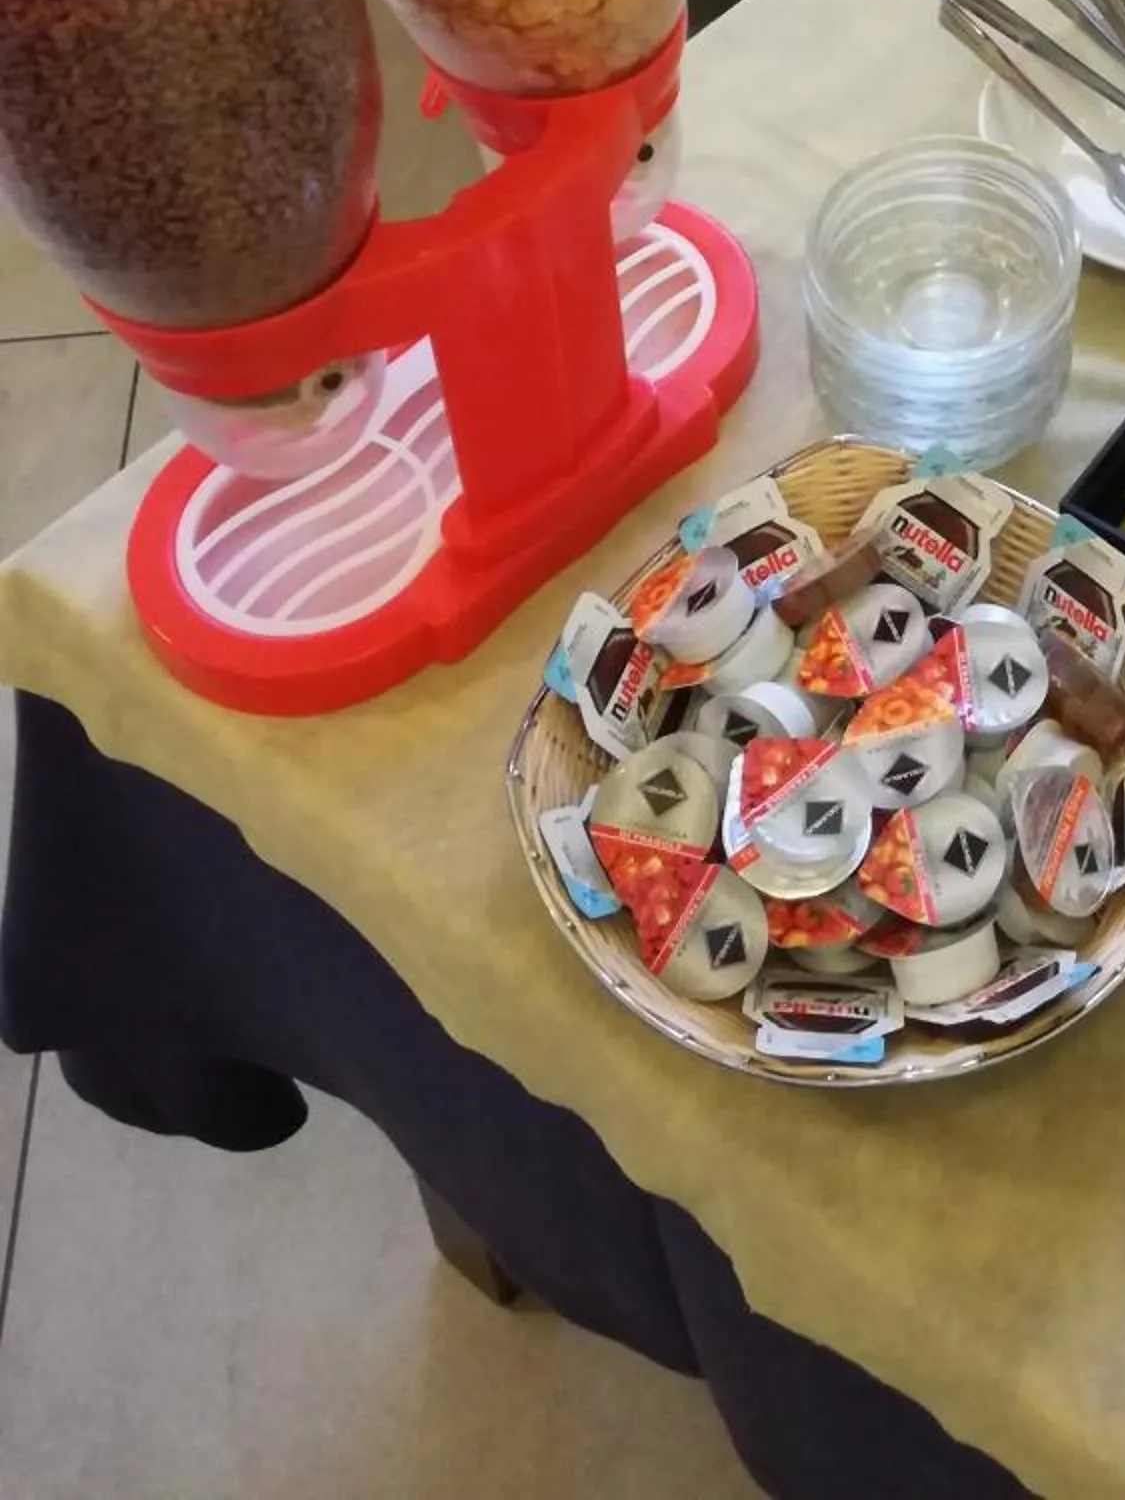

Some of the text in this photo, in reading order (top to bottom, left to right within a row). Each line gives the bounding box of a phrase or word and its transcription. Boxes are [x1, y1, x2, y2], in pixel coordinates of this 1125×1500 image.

[742, 548, 797, 587] tella
[891, 515, 962, 573] nutella
[1045, 586, 1110, 642] nutella
[611, 644, 653, 722] nutella
